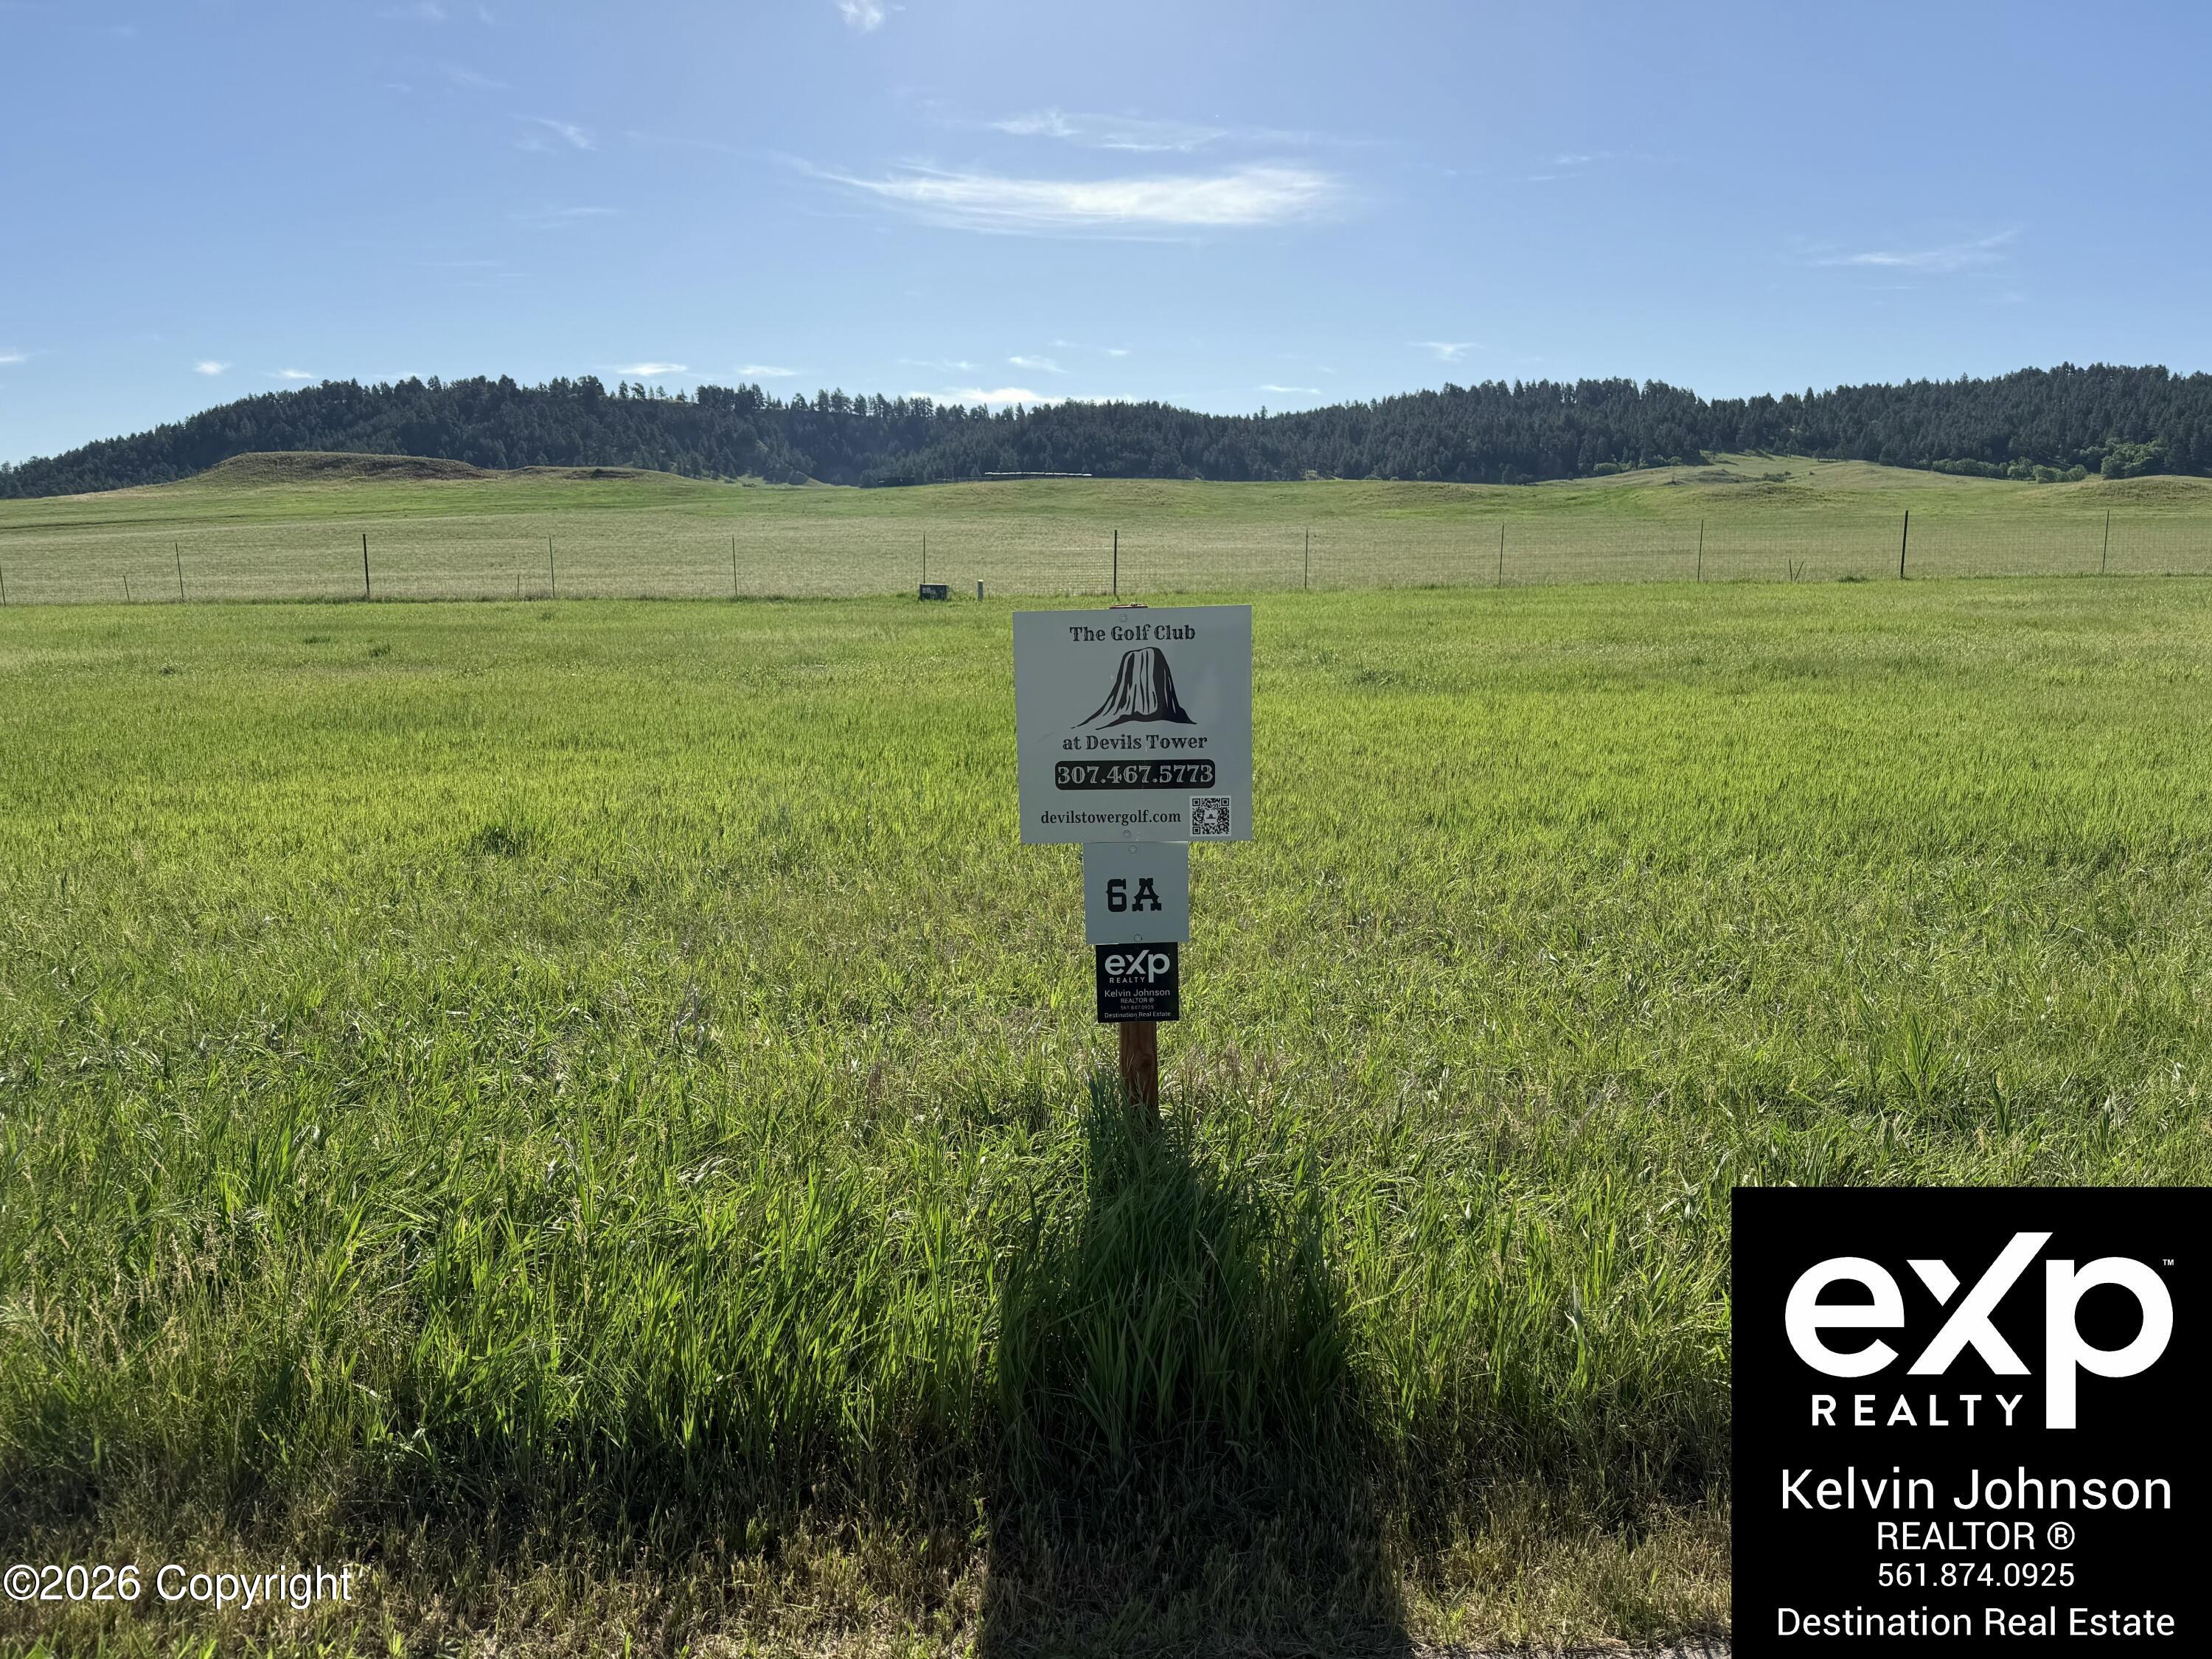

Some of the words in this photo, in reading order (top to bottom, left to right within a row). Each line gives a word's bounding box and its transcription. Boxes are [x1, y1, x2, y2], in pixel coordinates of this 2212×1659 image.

[1069, 626, 1105, 641] The
[1110, 624, 1151, 641] Golf
[1154, 625, 1196, 640] Club
[1062, 736, 1082, 750] at
[1085, 734, 1141, 750] Devils
[1146, 734, 1208, 749] Tower
[1057, 765, 1213, 785] 307.467.5773
[1040, 810, 1181, 827] devilstowergolf.com
[1106, 877, 1162, 912] 6A
[1105, 989, 1131, 997] Kelvin
[1133, 988, 1170, 997] Johnson
